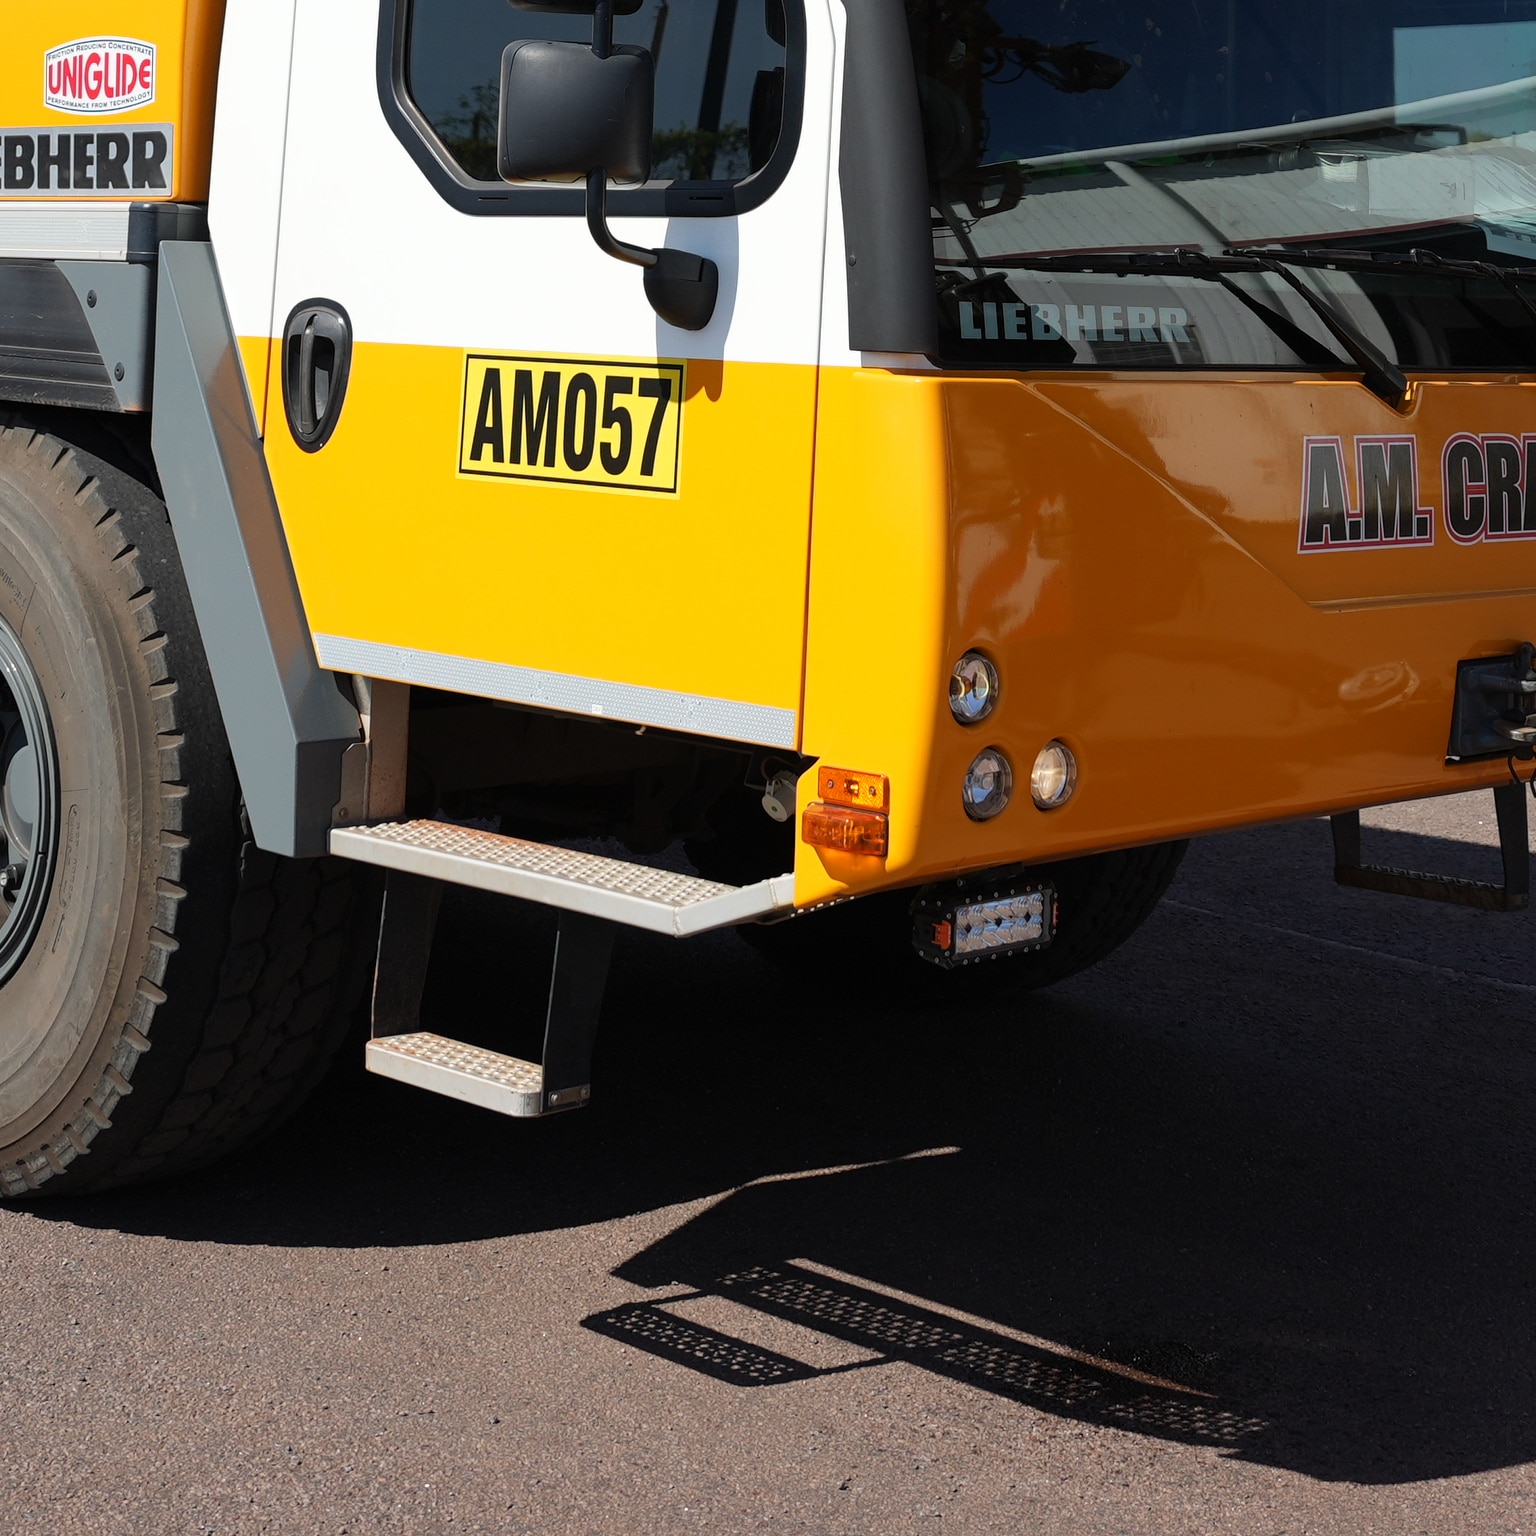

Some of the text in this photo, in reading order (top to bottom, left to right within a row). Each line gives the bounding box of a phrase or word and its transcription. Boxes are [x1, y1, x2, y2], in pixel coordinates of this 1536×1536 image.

[47, 91, 151, 109] PERFORMANCE FROM TECHNOLOGY
[48, 52, 151, 100] UNIGLIDE
[958, 300, 1191, 344] LIEBHERR
[469, 366, 675, 478] AM057
[1302, 435, 1434, 551] A.M.
